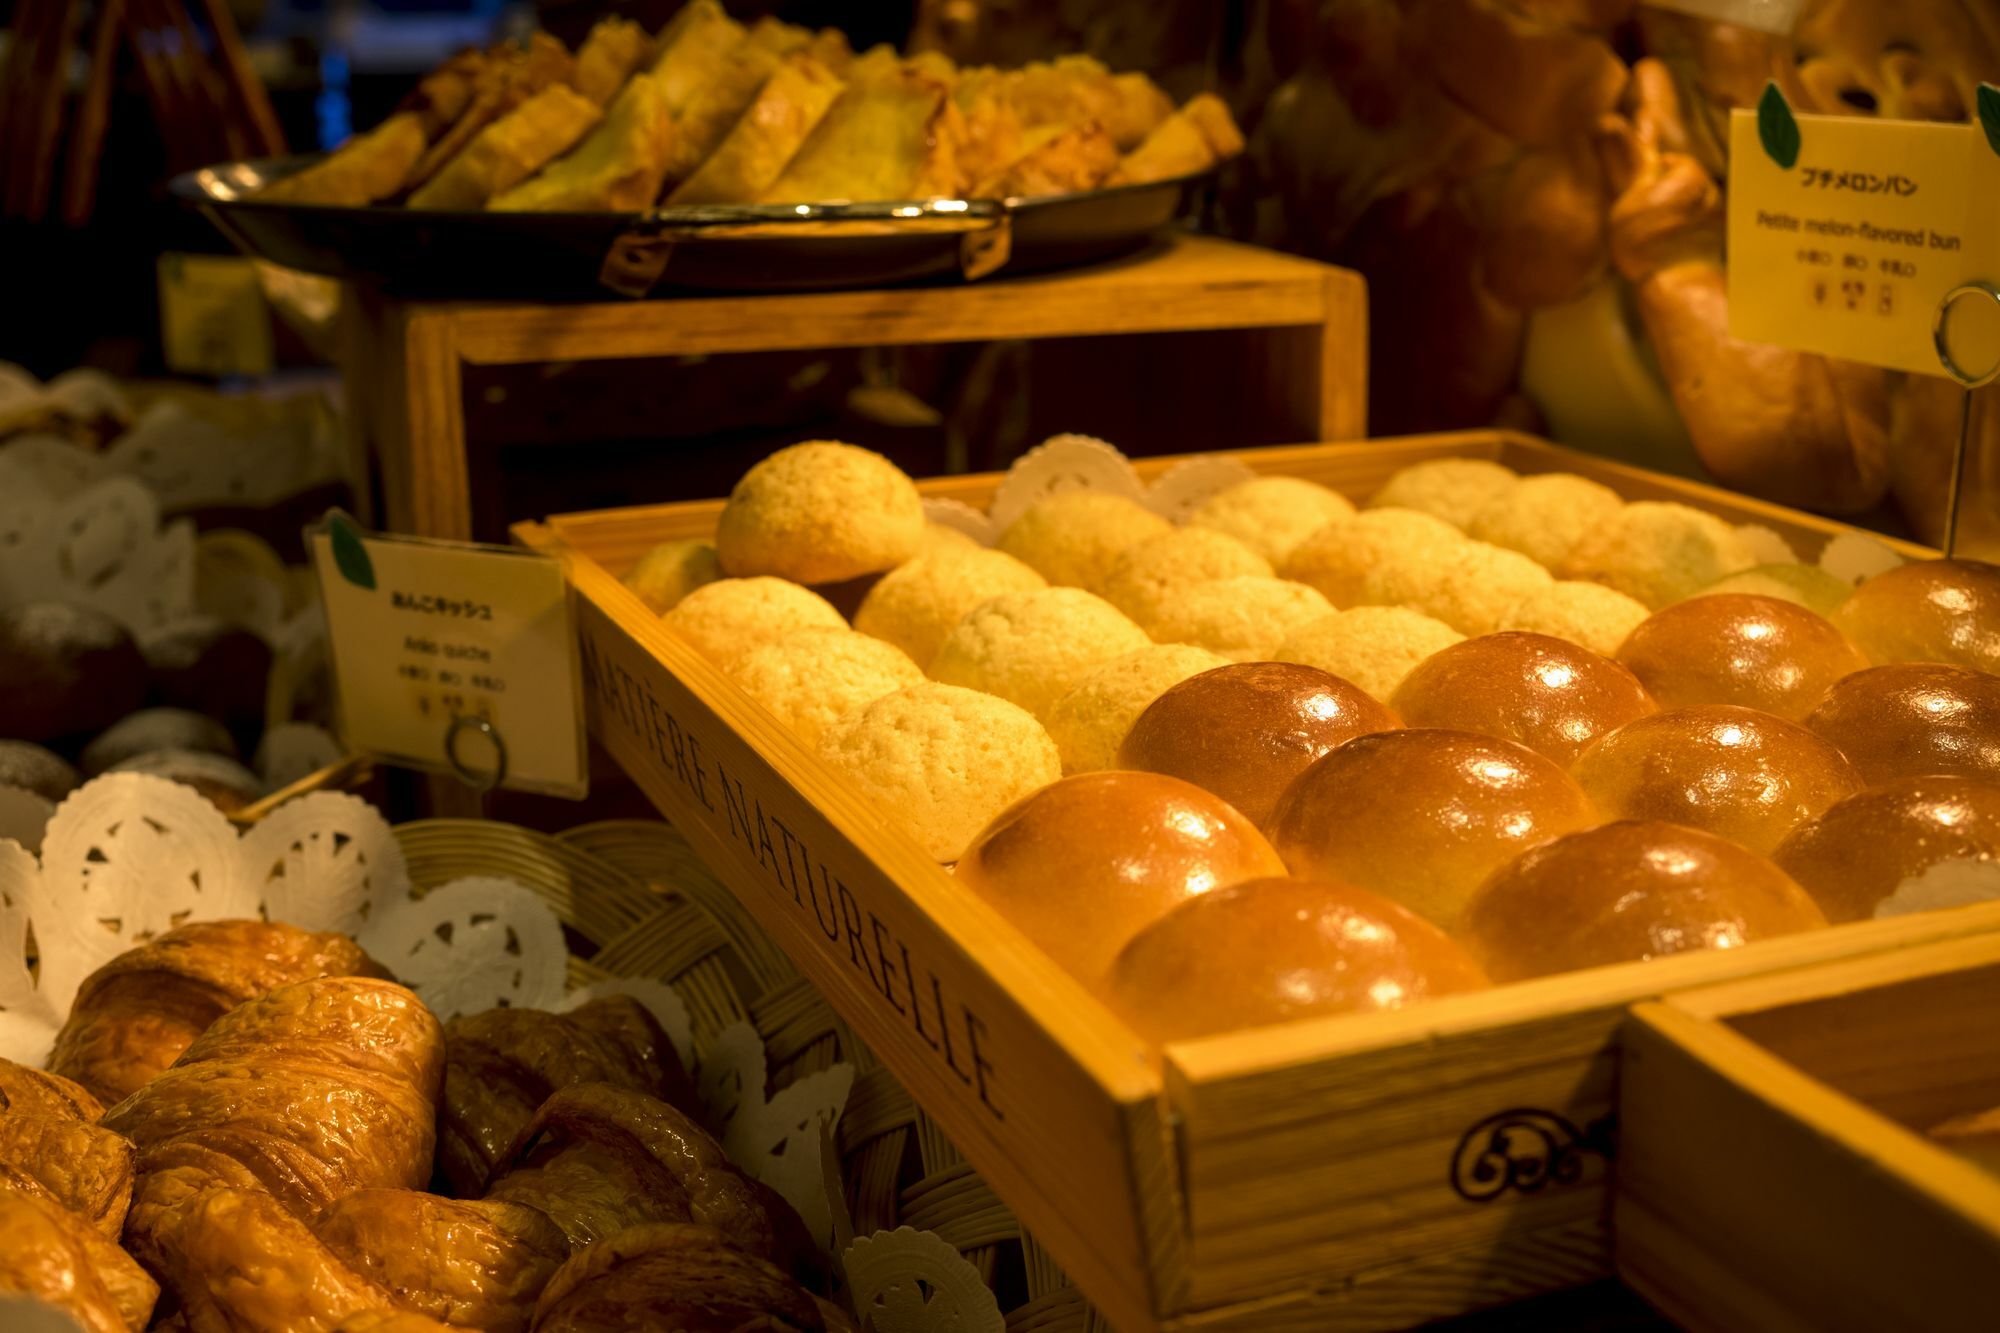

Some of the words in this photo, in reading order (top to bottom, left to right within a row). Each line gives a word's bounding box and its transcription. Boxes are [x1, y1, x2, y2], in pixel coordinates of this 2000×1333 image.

[1801, 166, 1919, 197] プチメロンパン
[1756, 210, 1799, 231] Petite
[1804, 218, 1924, 248] melon-flavored
[1929, 229, 1961, 252] bun
[717, 761, 1004, 1121] NATURELLE
